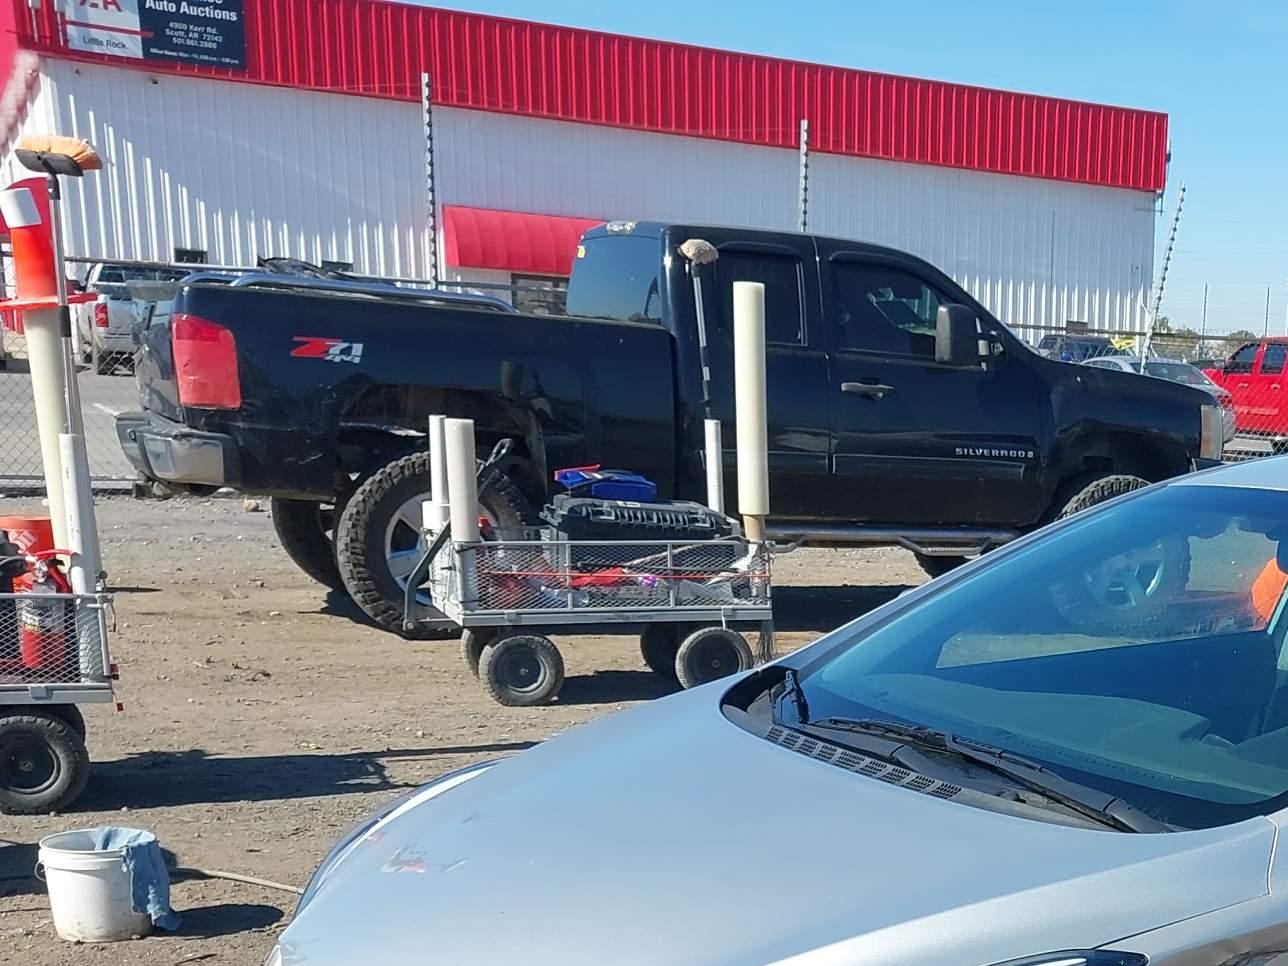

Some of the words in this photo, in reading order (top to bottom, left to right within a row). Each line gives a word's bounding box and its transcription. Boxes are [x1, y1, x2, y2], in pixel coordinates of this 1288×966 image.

[145, 0, 177, 13] Auto
[180, 2, 238, 21] Auctions
[189, 24, 205, 33] Kerr
[291, 335, 363, 357] Z71
[955, 447, 1026, 458] SILVERADO
